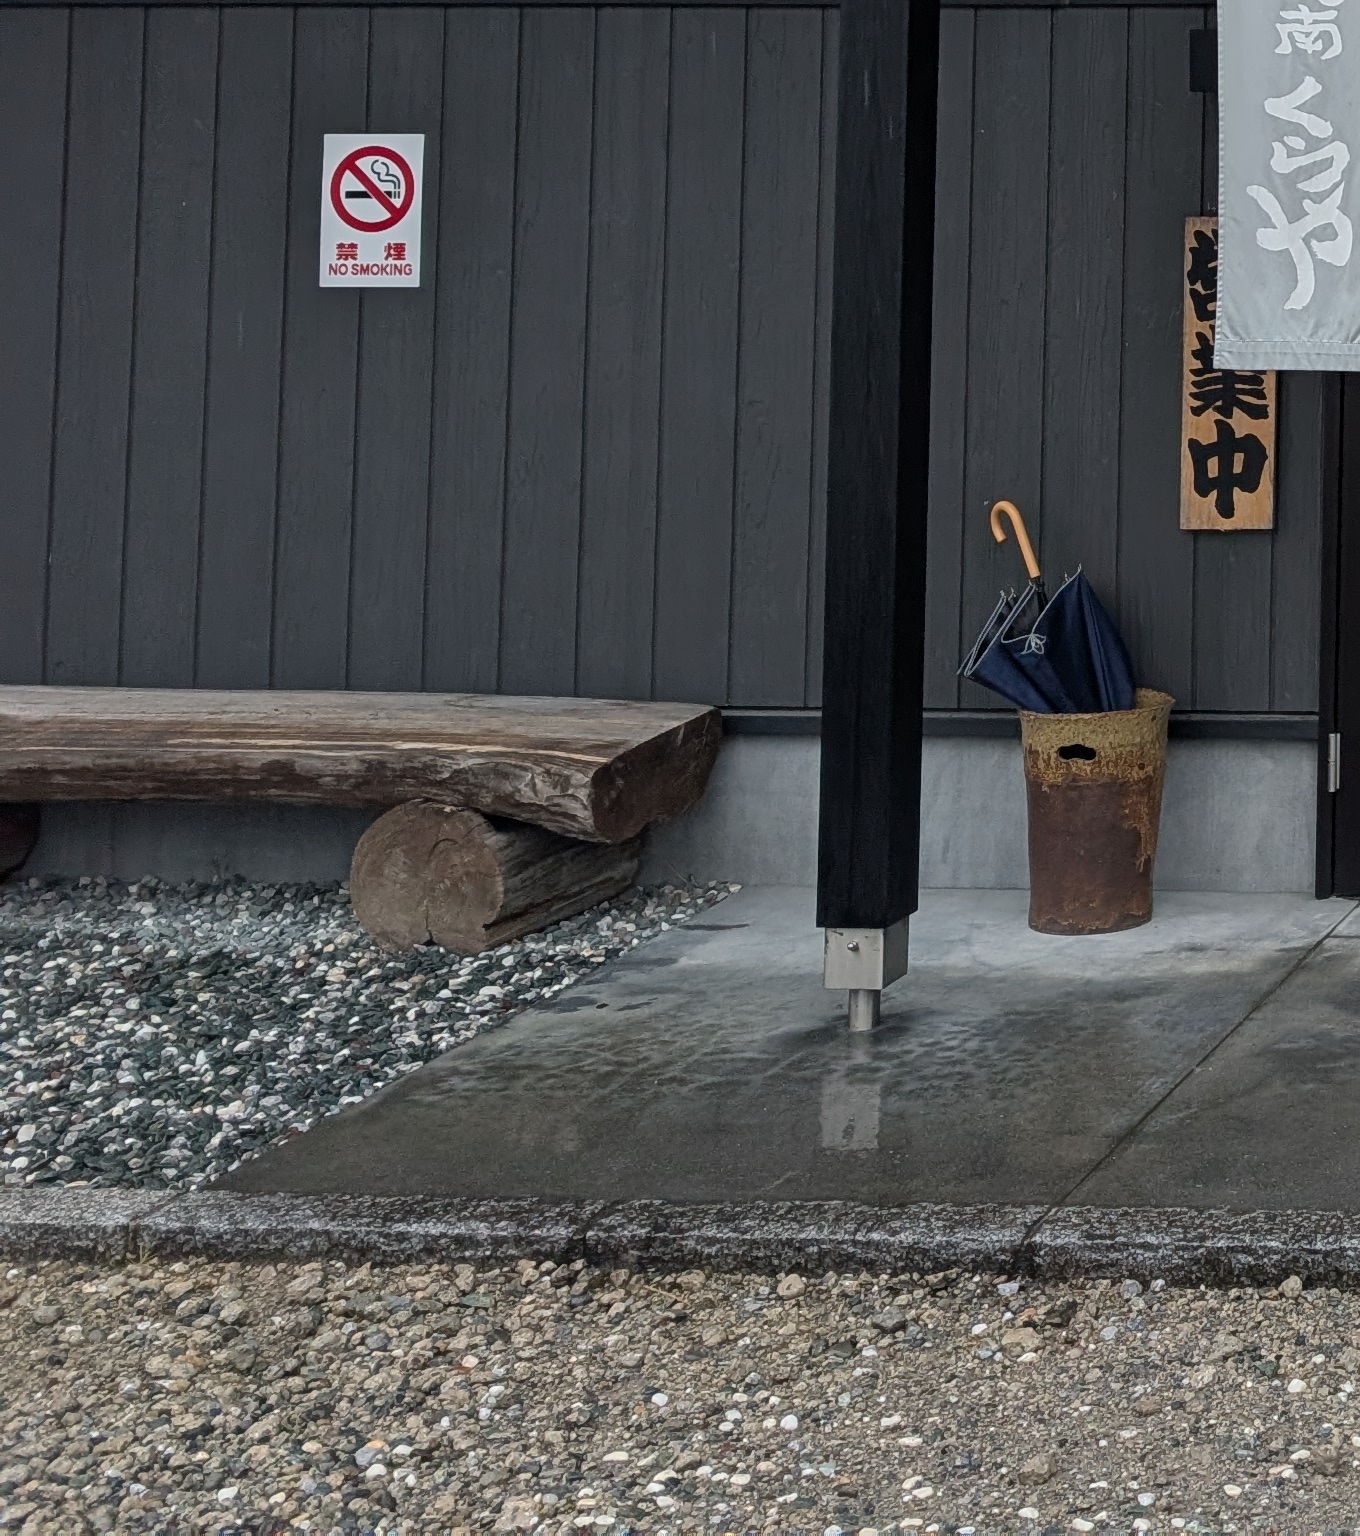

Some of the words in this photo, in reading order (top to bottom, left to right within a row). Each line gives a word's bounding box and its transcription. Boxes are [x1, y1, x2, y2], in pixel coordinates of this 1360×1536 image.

[335, 242, 407, 262] 禁煙
[328, 263, 348, 276] NO
[350, 263, 413, 276] SMOKING
